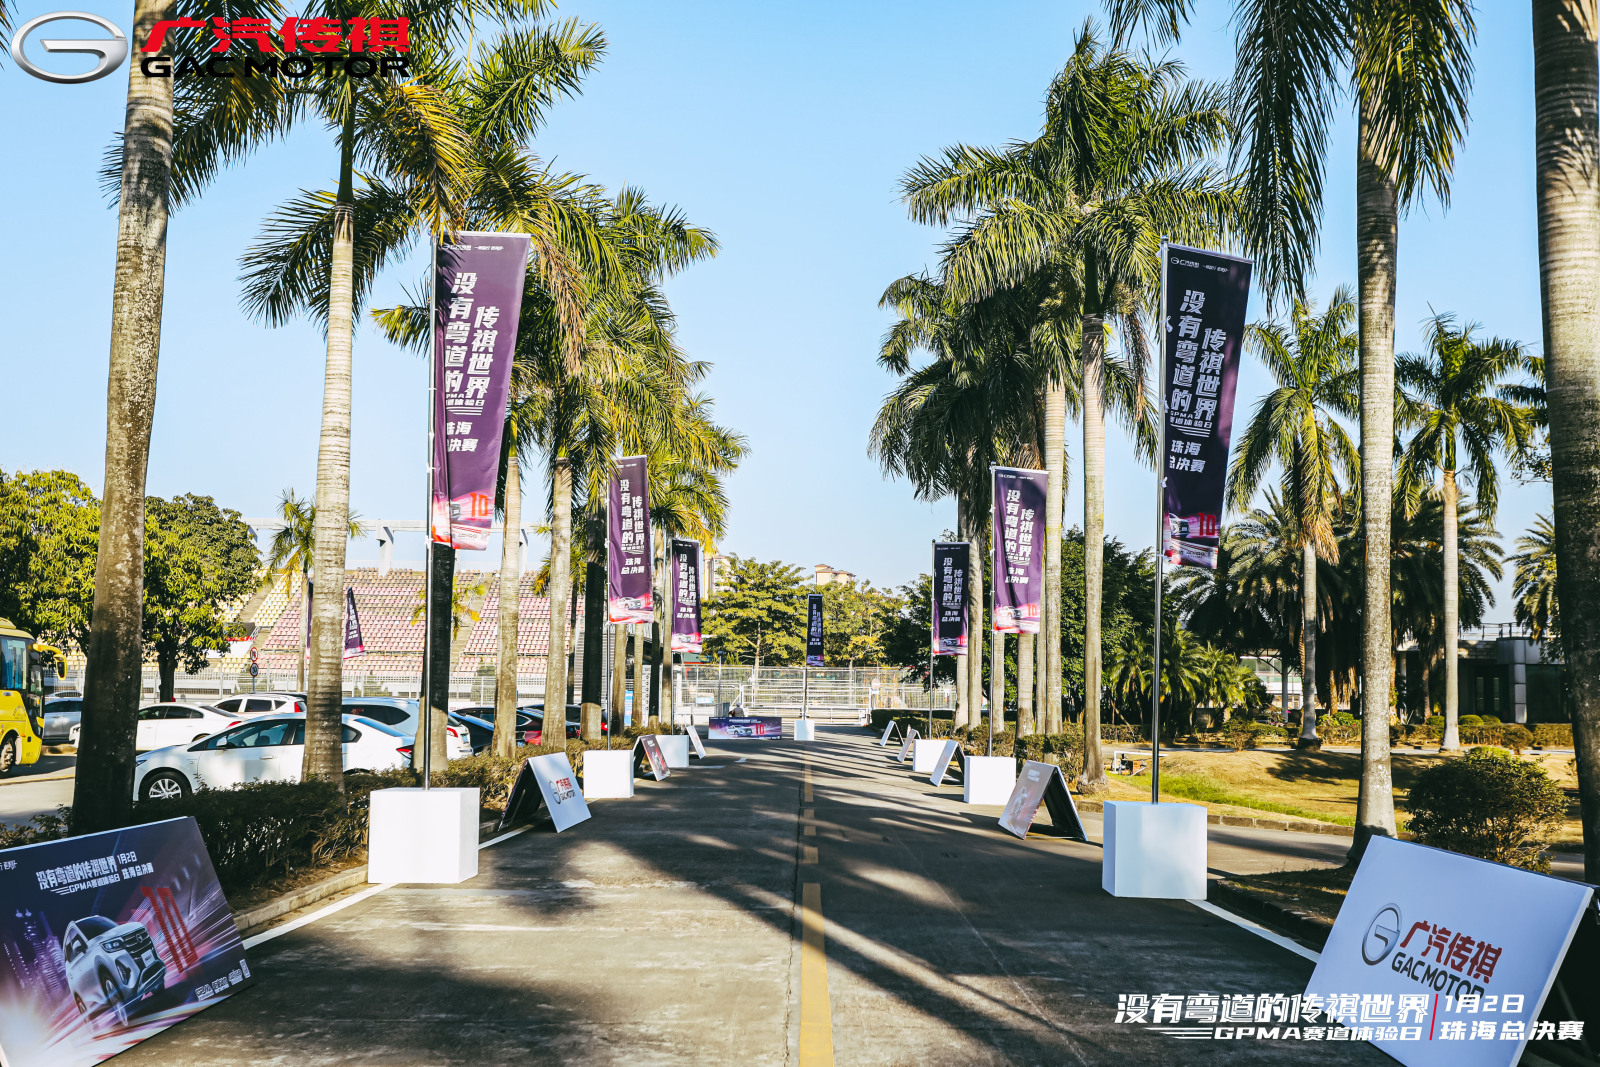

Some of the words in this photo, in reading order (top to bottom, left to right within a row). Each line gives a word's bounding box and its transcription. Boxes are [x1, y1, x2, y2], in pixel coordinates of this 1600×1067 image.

[445, 272, 477, 392] 没有弯道的
[465, 306, 500, 399] 传祺世界
[1170, 289, 1206, 412] 没有弯道的
[1194, 328, 1227, 421] 传祺世界
[446, 438, 478, 452] 决赛
[1198, 512, 1216, 536] 10
[36, 855, 118, 890] 没有弯道的传祺世界
[117, 851, 137, 865] 1月2日
[1391, 951, 1425, 982] GAC
[1400, 920, 1503, 984] 广汽传祺
